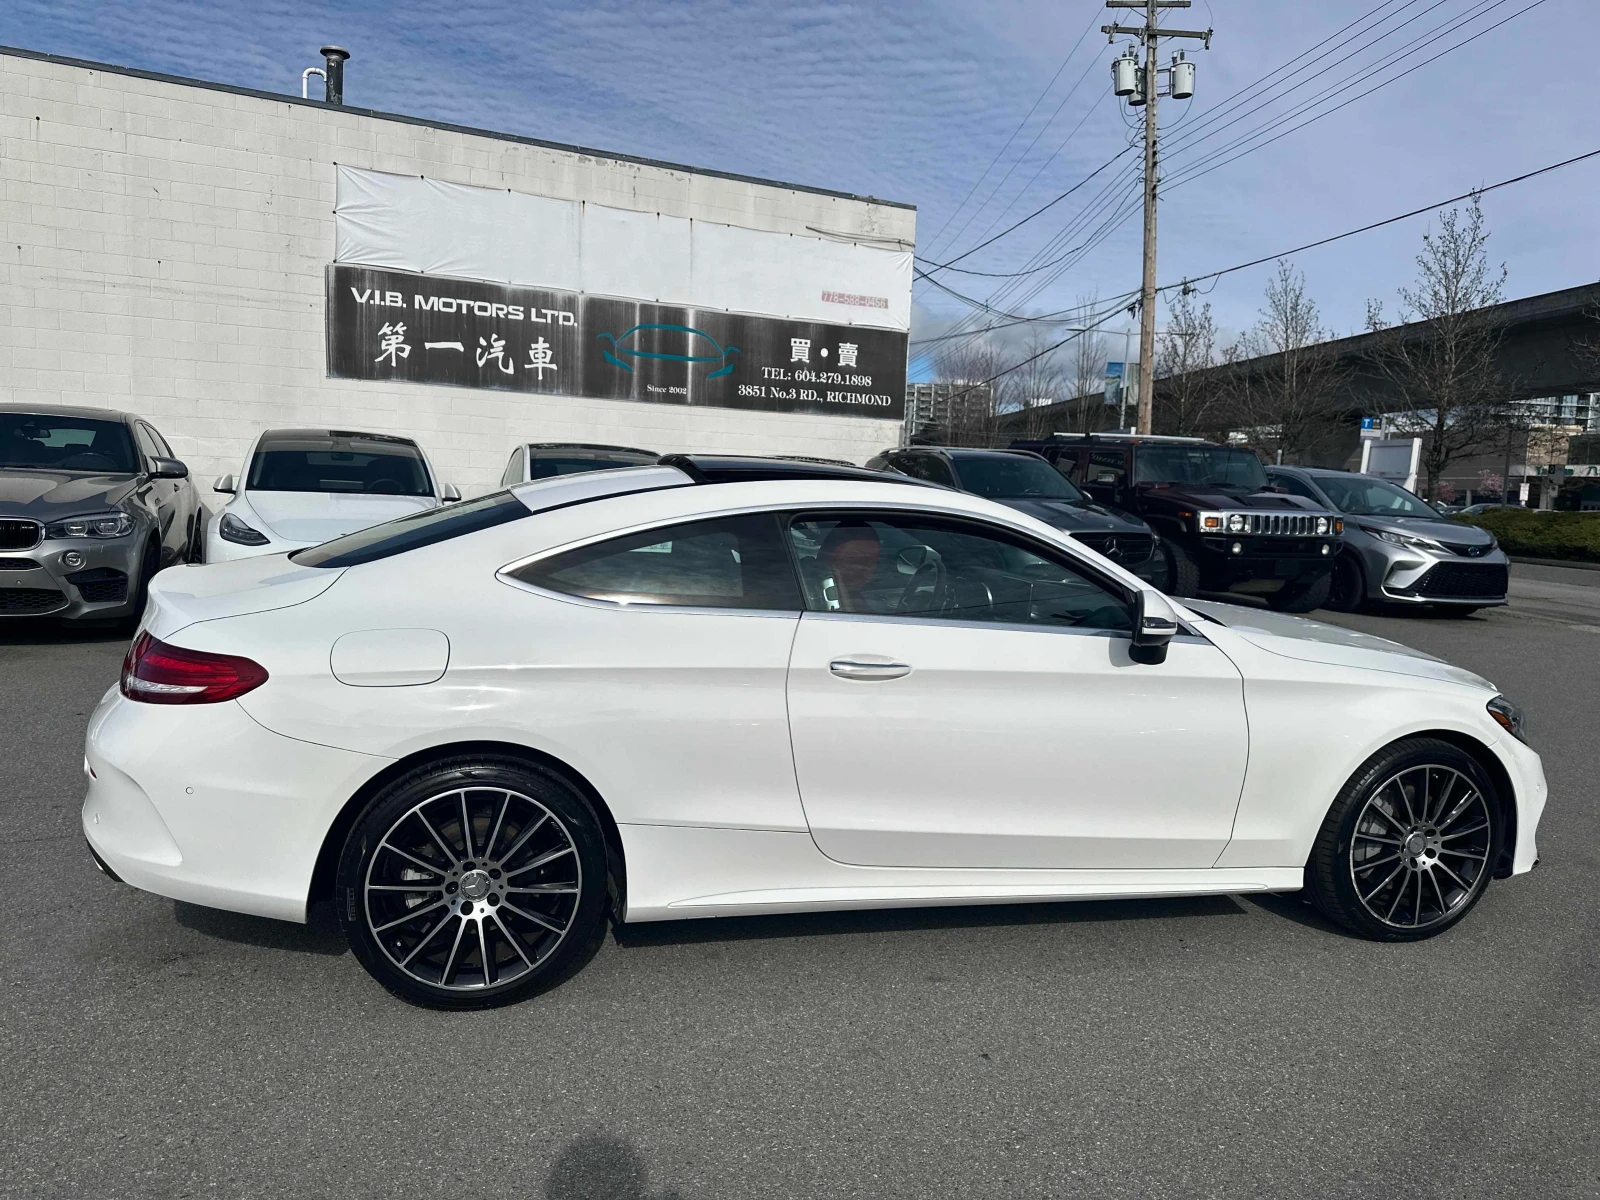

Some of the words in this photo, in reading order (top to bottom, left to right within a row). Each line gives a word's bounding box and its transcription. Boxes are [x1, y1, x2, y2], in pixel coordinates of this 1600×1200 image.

[351, 287, 407, 308] V.I.B.
[414, 294, 525, 320] MOTORS
[530, 307, 578, 327] LTD.
[822, 291, 887, 308] 778-588-0456
[761, 366, 791, 380] TEL:
[795, 369, 872, 387] 604.279.1898
[646, 383, 667, 393] Since
[668, 386, 687, 395] 2002
[738, 384, 766, 397] 3851
[770, 386, 796, 400] No.3
[799, 389, 823, 403] RD.,
[826, 391, 892, 406] RICHMOND
